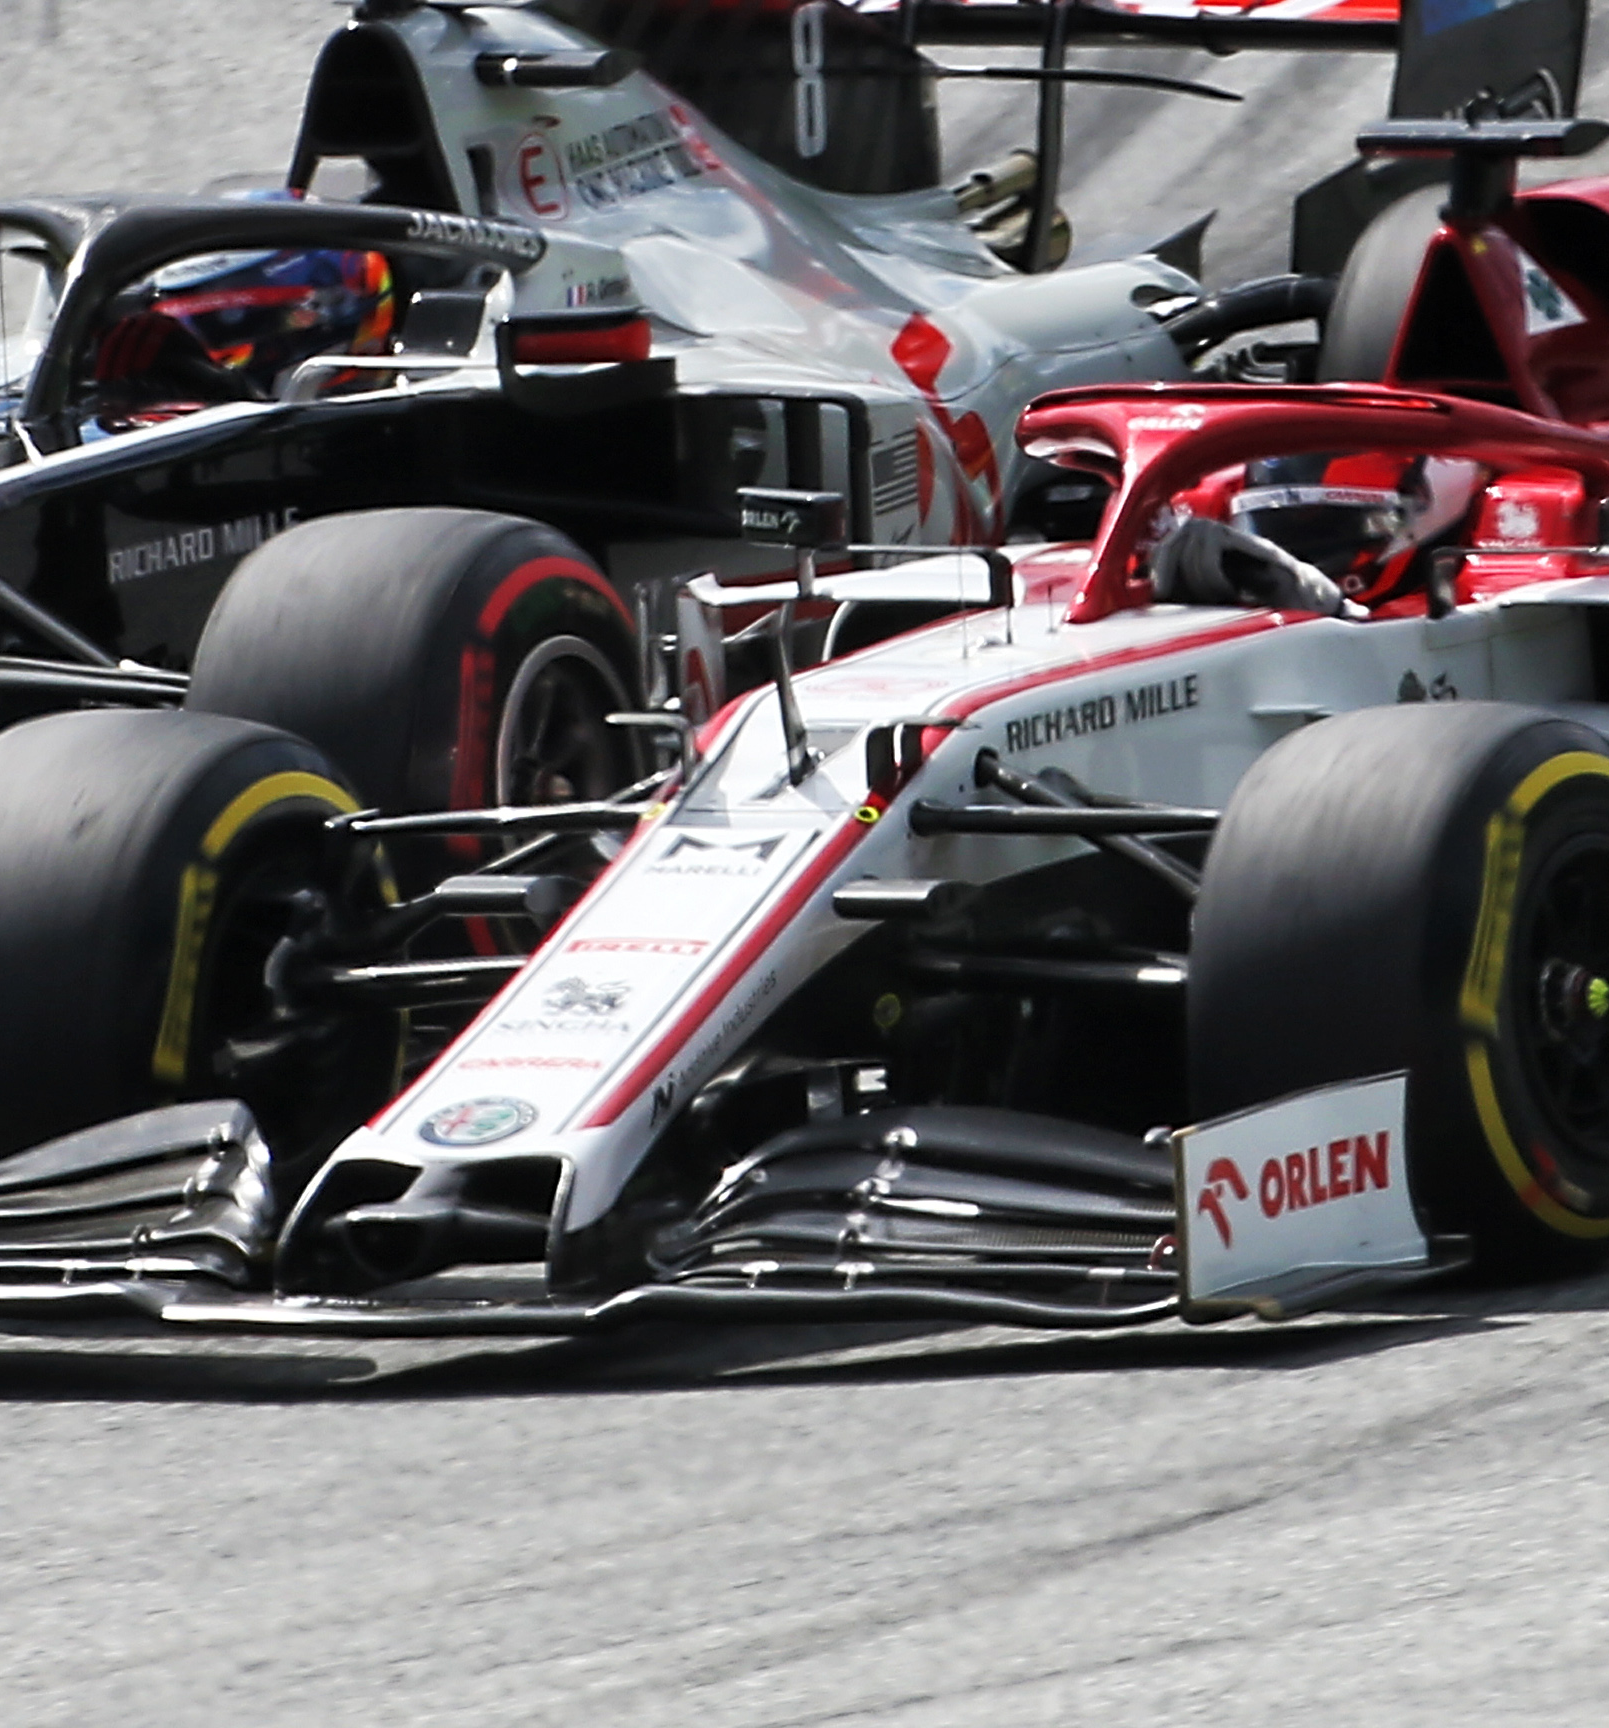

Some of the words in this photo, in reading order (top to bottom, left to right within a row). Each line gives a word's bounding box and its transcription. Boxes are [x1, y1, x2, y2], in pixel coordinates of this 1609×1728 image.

[793, 0, 828, 159] 8
[519, 146, 559, 214] E
[108, 527, 214, 584] RICHARD
[1006, 695, 1116, 753] RICHARD
[1126, 674, 1198, 723] MILLE
[563, 936, 710, 957] PIRELLI
[1258, 1129, 1390, 1219] ORLEN
